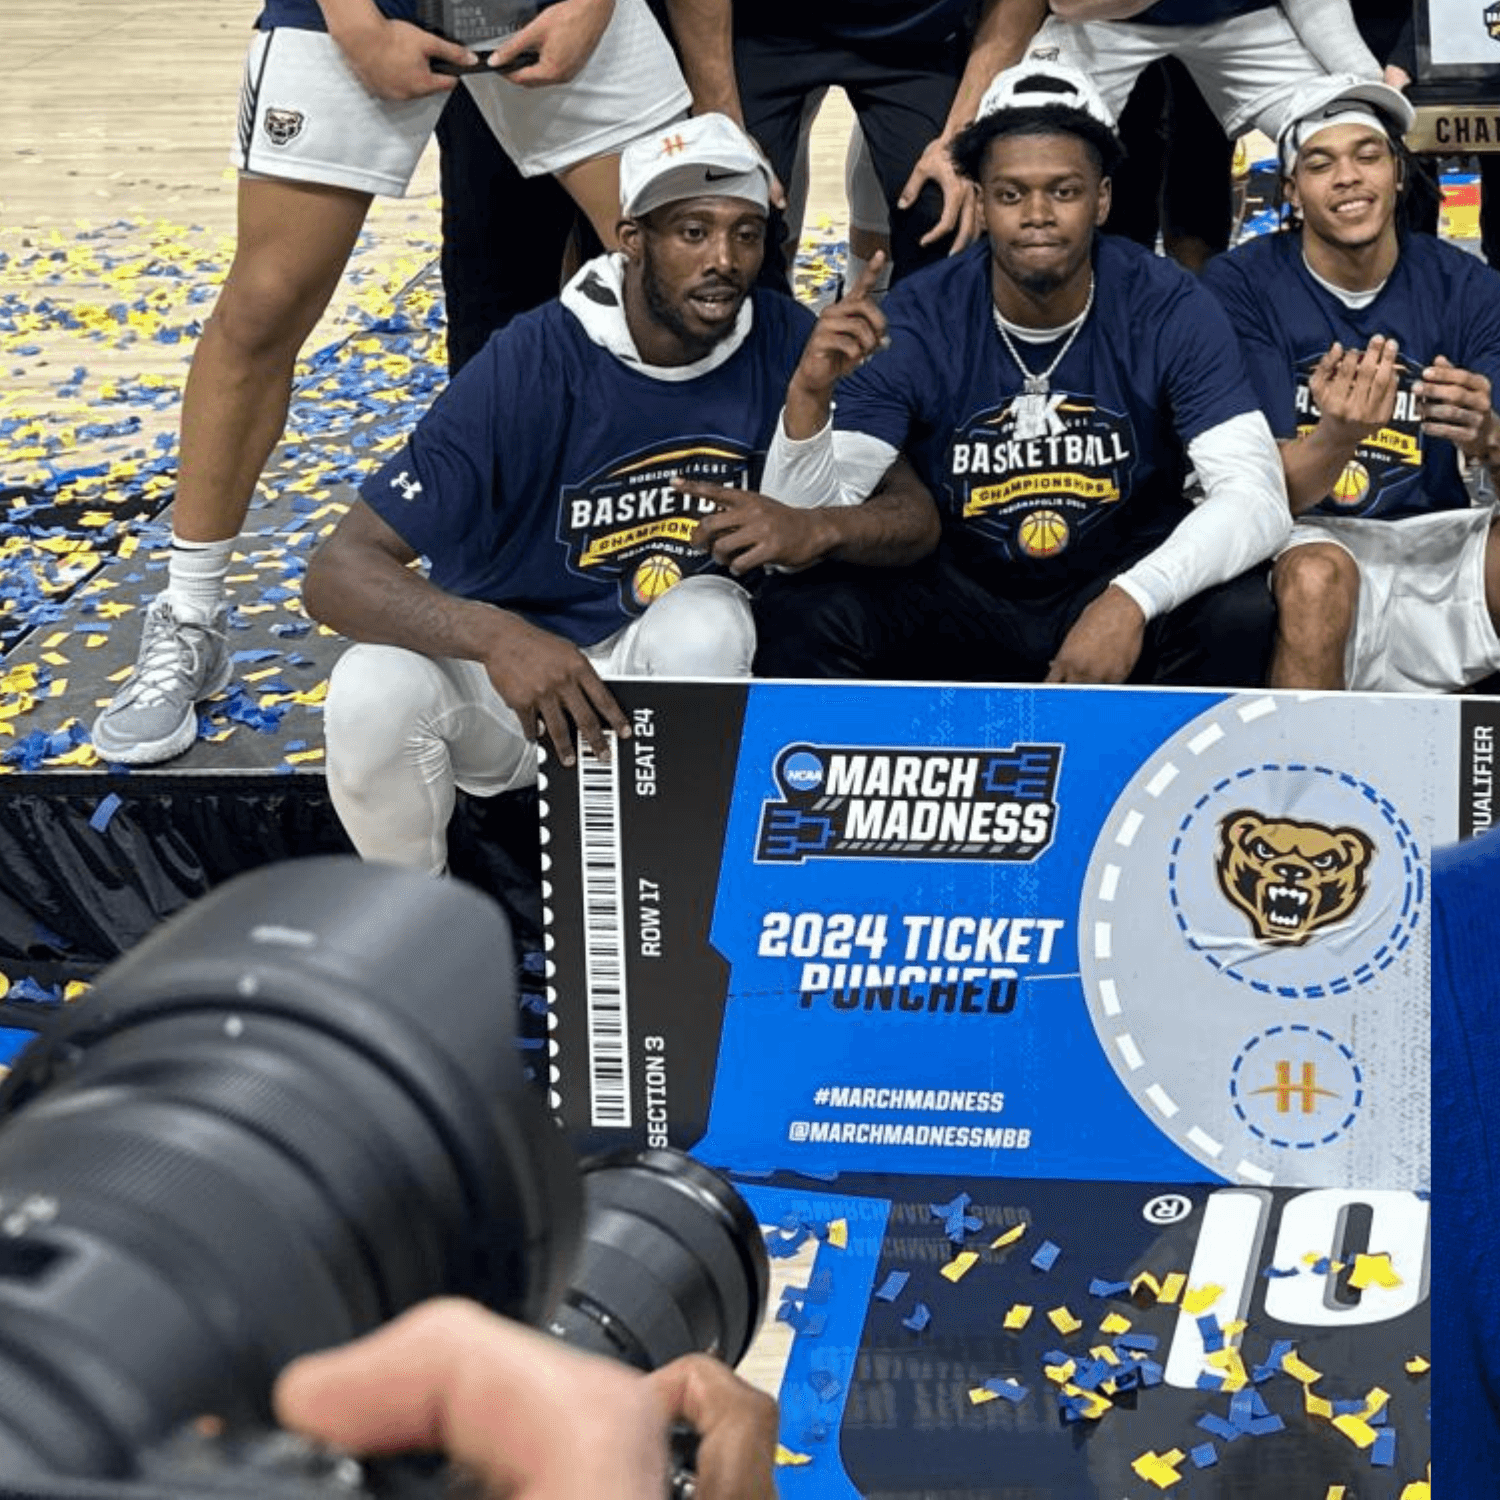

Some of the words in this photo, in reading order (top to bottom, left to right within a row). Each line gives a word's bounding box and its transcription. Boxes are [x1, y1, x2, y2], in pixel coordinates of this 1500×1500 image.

[952, 432, 1131, 475] BASKETBALL
[978, 477, 1105, 501] CHAMPIONSHIPS
[599, 522, 690, 550] CHAMPION
[634, 708, 654, 735] 24
[635, 738, 657, 797] SEAT
[786, 768, 824, 783] NCAA
[825, 755, 979, 798] MARCH
[843, 801, 1051, 844] MADNESS
[639, 878, 661, 907] 17
[641, 912, 663, 958] ROW
[758, 911, 889, 959] 2024
[901, 914, 1065, 964] TICKET
[799, 962, 1019, 1015] PUNCHED
[645, 1035, 665, 1052] 3
[646, 1054, 669, 1149] SECTION
[812, 1086, 1005, 1113] #MARCHMADNESS
[788, 1120, 1032, 1150] @MARCHMADNESSMBB
